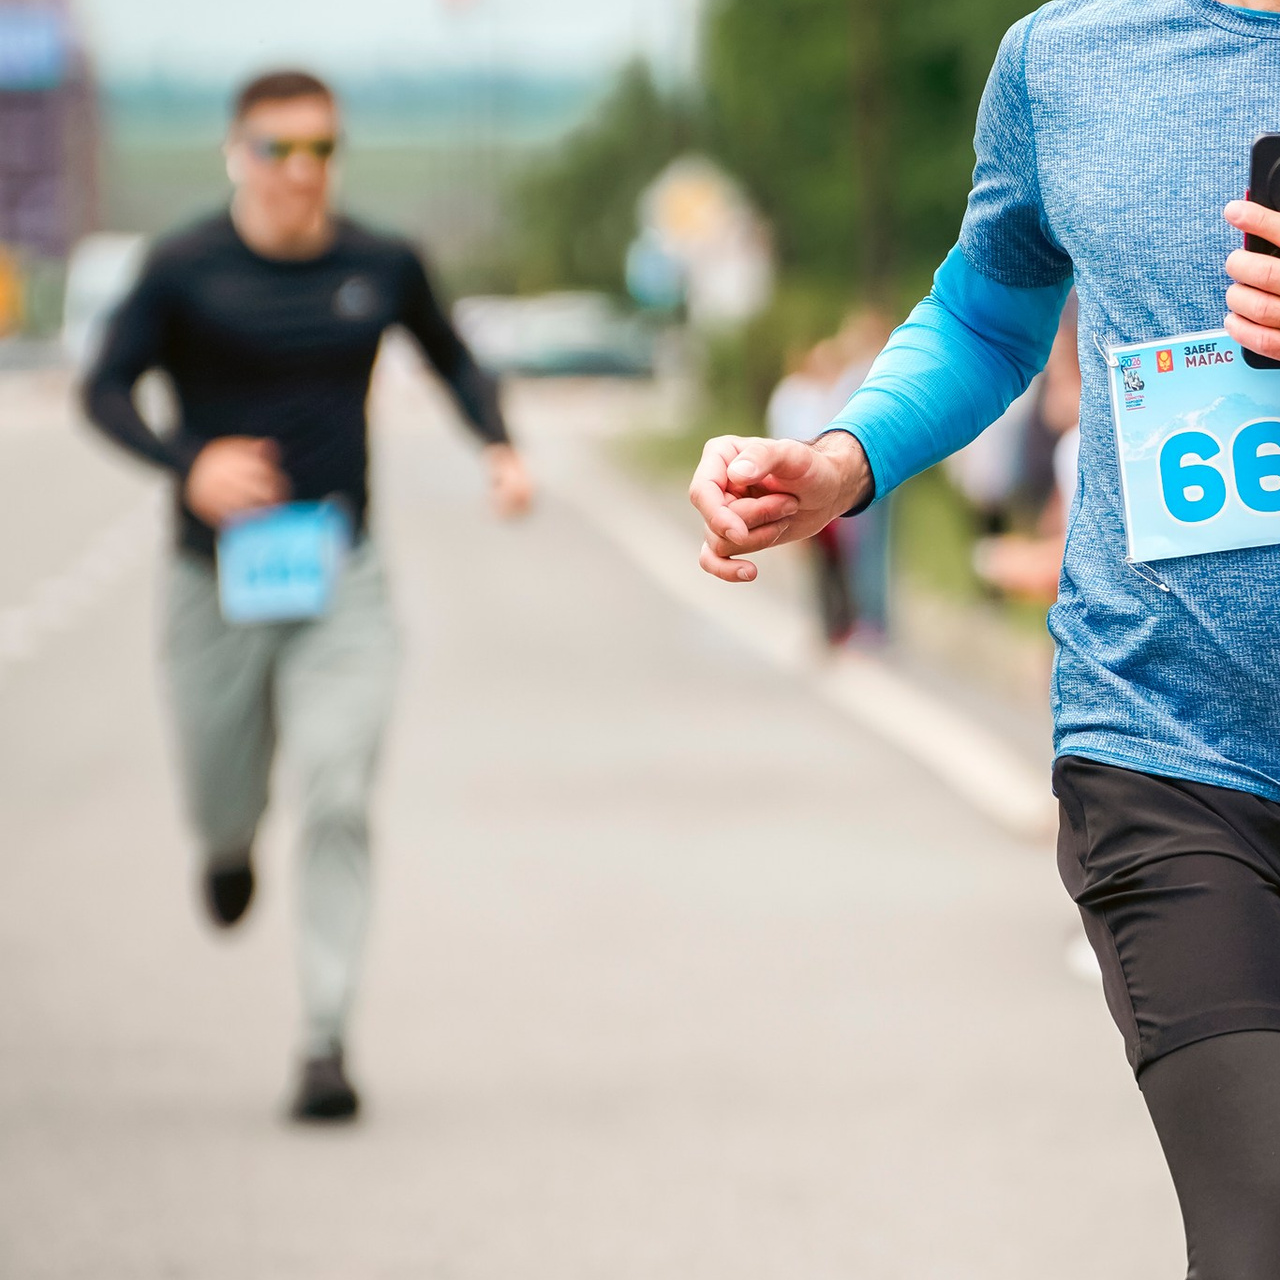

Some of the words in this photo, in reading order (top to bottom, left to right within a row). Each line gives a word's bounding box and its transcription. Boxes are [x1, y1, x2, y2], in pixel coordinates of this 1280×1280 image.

[1184, 342, 1218, 355] ЗАБЕГ
[1122, 357, 1141, 367] 2026
[1185, 350, 1234, 368] МАГАС
